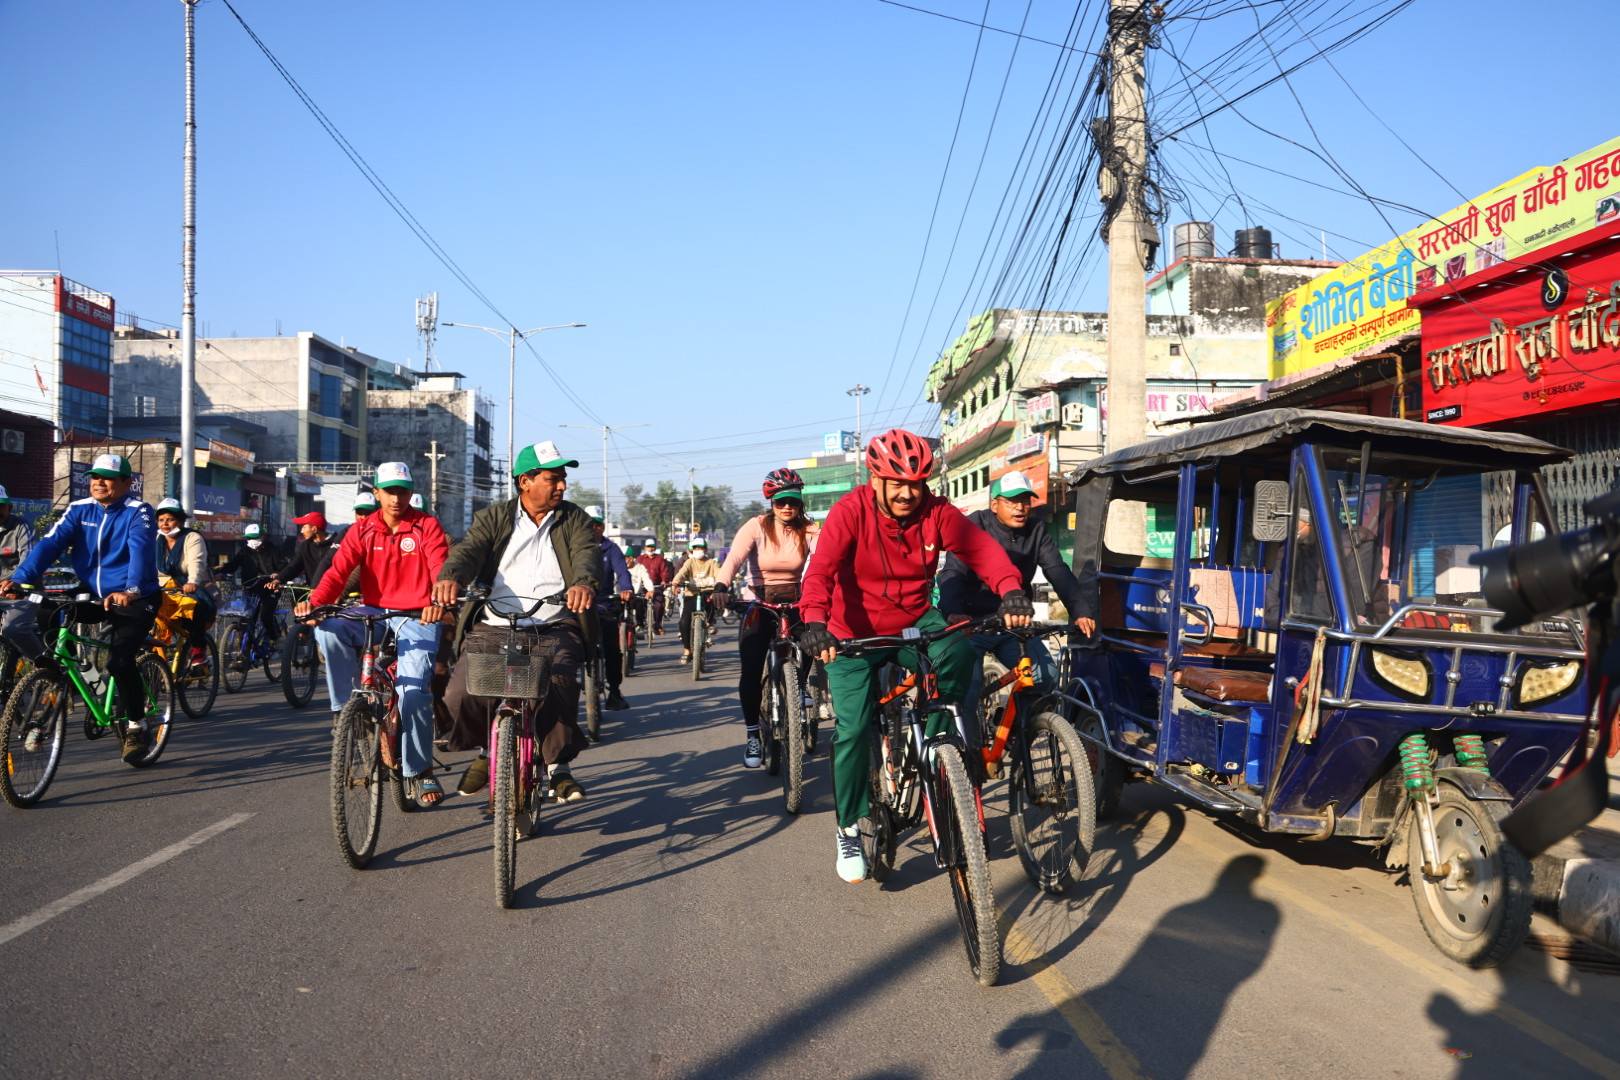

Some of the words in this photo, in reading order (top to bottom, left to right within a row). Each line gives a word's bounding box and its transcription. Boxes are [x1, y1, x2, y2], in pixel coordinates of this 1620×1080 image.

[1418, 205, 1480, 260] सरस्वती
[1485, 195, 1517, 236] सुन
[1300, 281, 1365, 340] शोभित
[1369, 247, 1415, 308] बेबी
[1427, 317, 1511, 392] सरस्वती
[1515, 313, 1563, 382] सुन
[1146, 394, 1169, 412] RT
[202, 492, 225, 505] vivo
